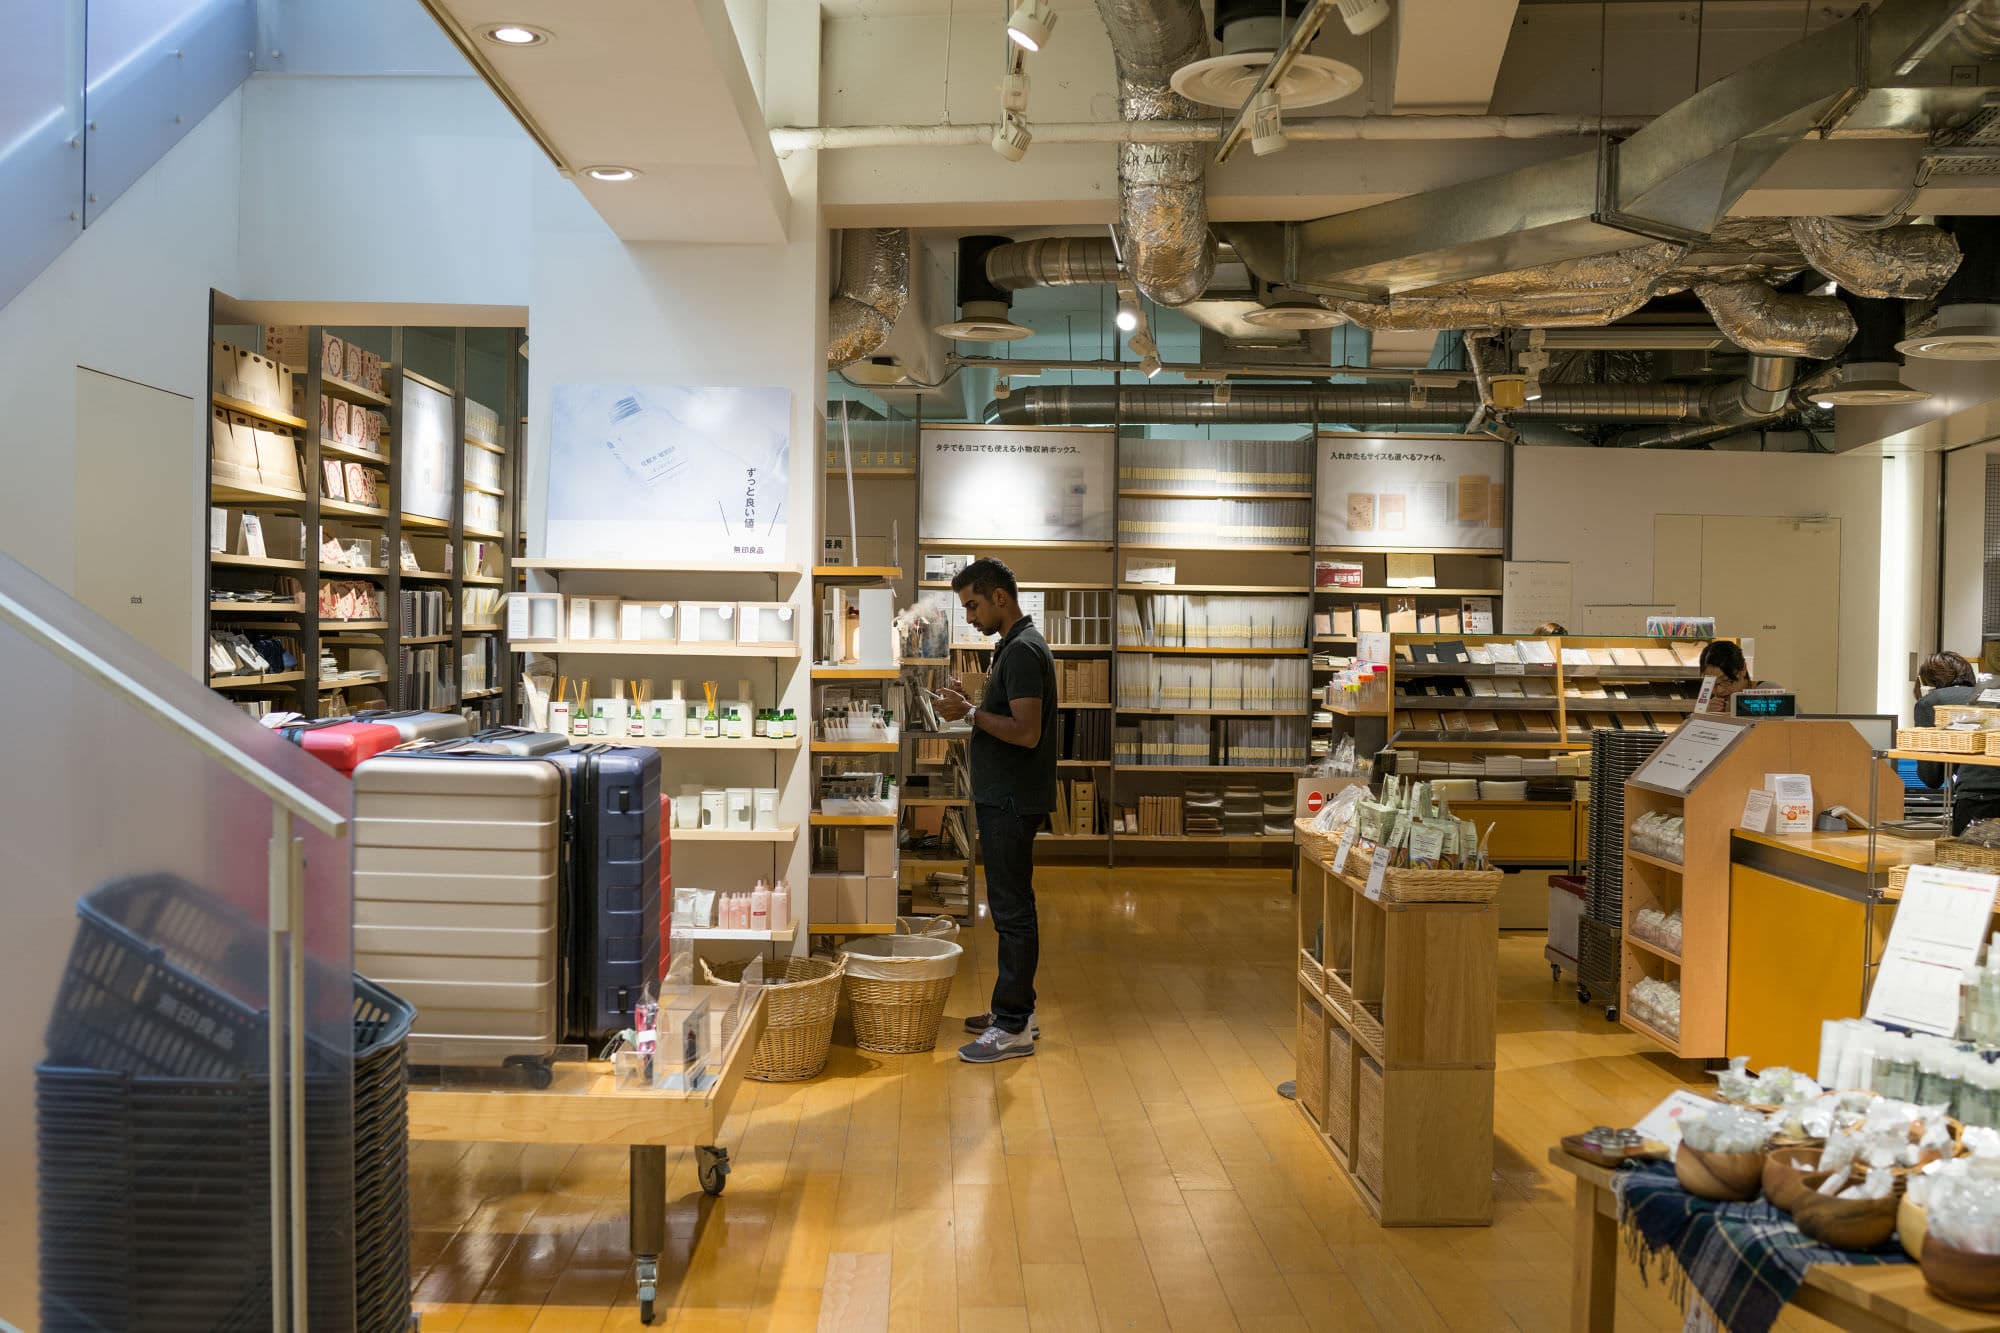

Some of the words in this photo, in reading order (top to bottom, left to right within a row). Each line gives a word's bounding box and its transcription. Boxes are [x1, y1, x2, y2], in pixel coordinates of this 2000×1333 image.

[936, 444, 1081, 455] タテでもヨコでも使える小物収納ボックス。
[1330, 451, 1446, 462] 入れかたもサイズも選べるファイル。
[733, 546, 765, 555] 無印良品
